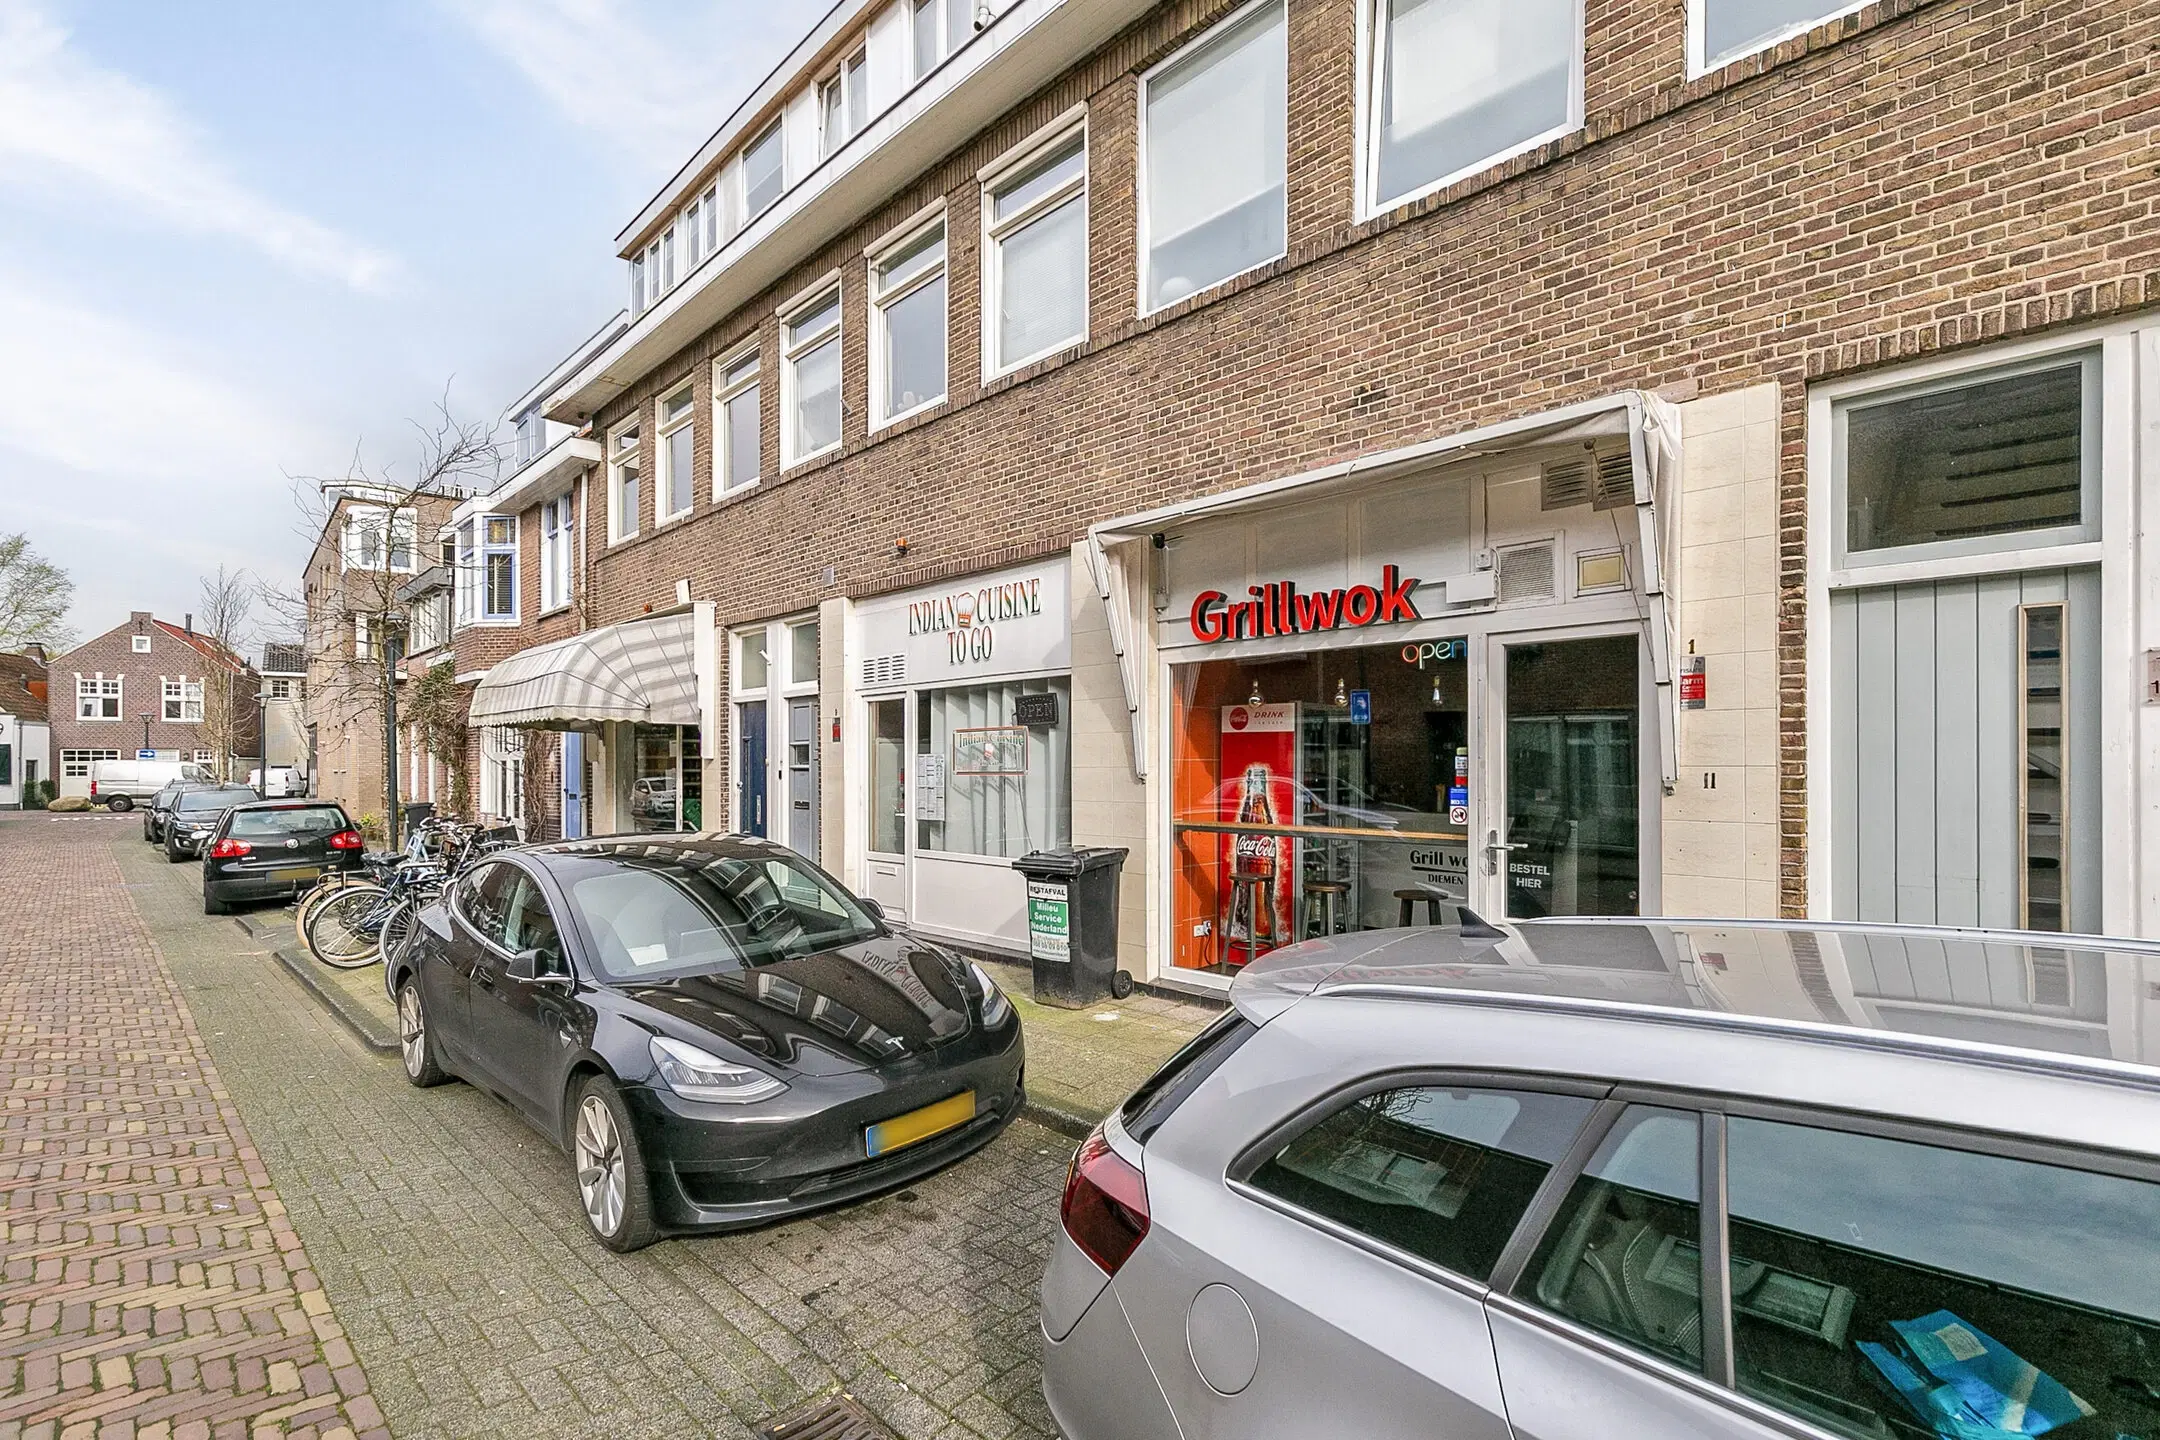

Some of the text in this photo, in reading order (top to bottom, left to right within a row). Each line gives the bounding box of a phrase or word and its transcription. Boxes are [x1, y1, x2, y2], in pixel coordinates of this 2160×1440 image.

[908, 578, 1041, 636] INDIAN CUISINE
[1191, 564, 1423, 643] Grillwok
[947, 625, 993, 665] TO GO
[1401, 638, 1468, 670] open
[1018, 703, 1054, 718] OPEN
[1237, 834, 1276, 857] Coca-Cola
[1409, 849, 1444, 866] Grill
[1509, 862, 1551, 876] BESTEL
[1427, 874, 1464, 886] DIEMEN
[1516, 877, 1542, 889] HIER
[1034, 912, 1062, 923] Service
[1031, 922, 1068, 934] Nederland
